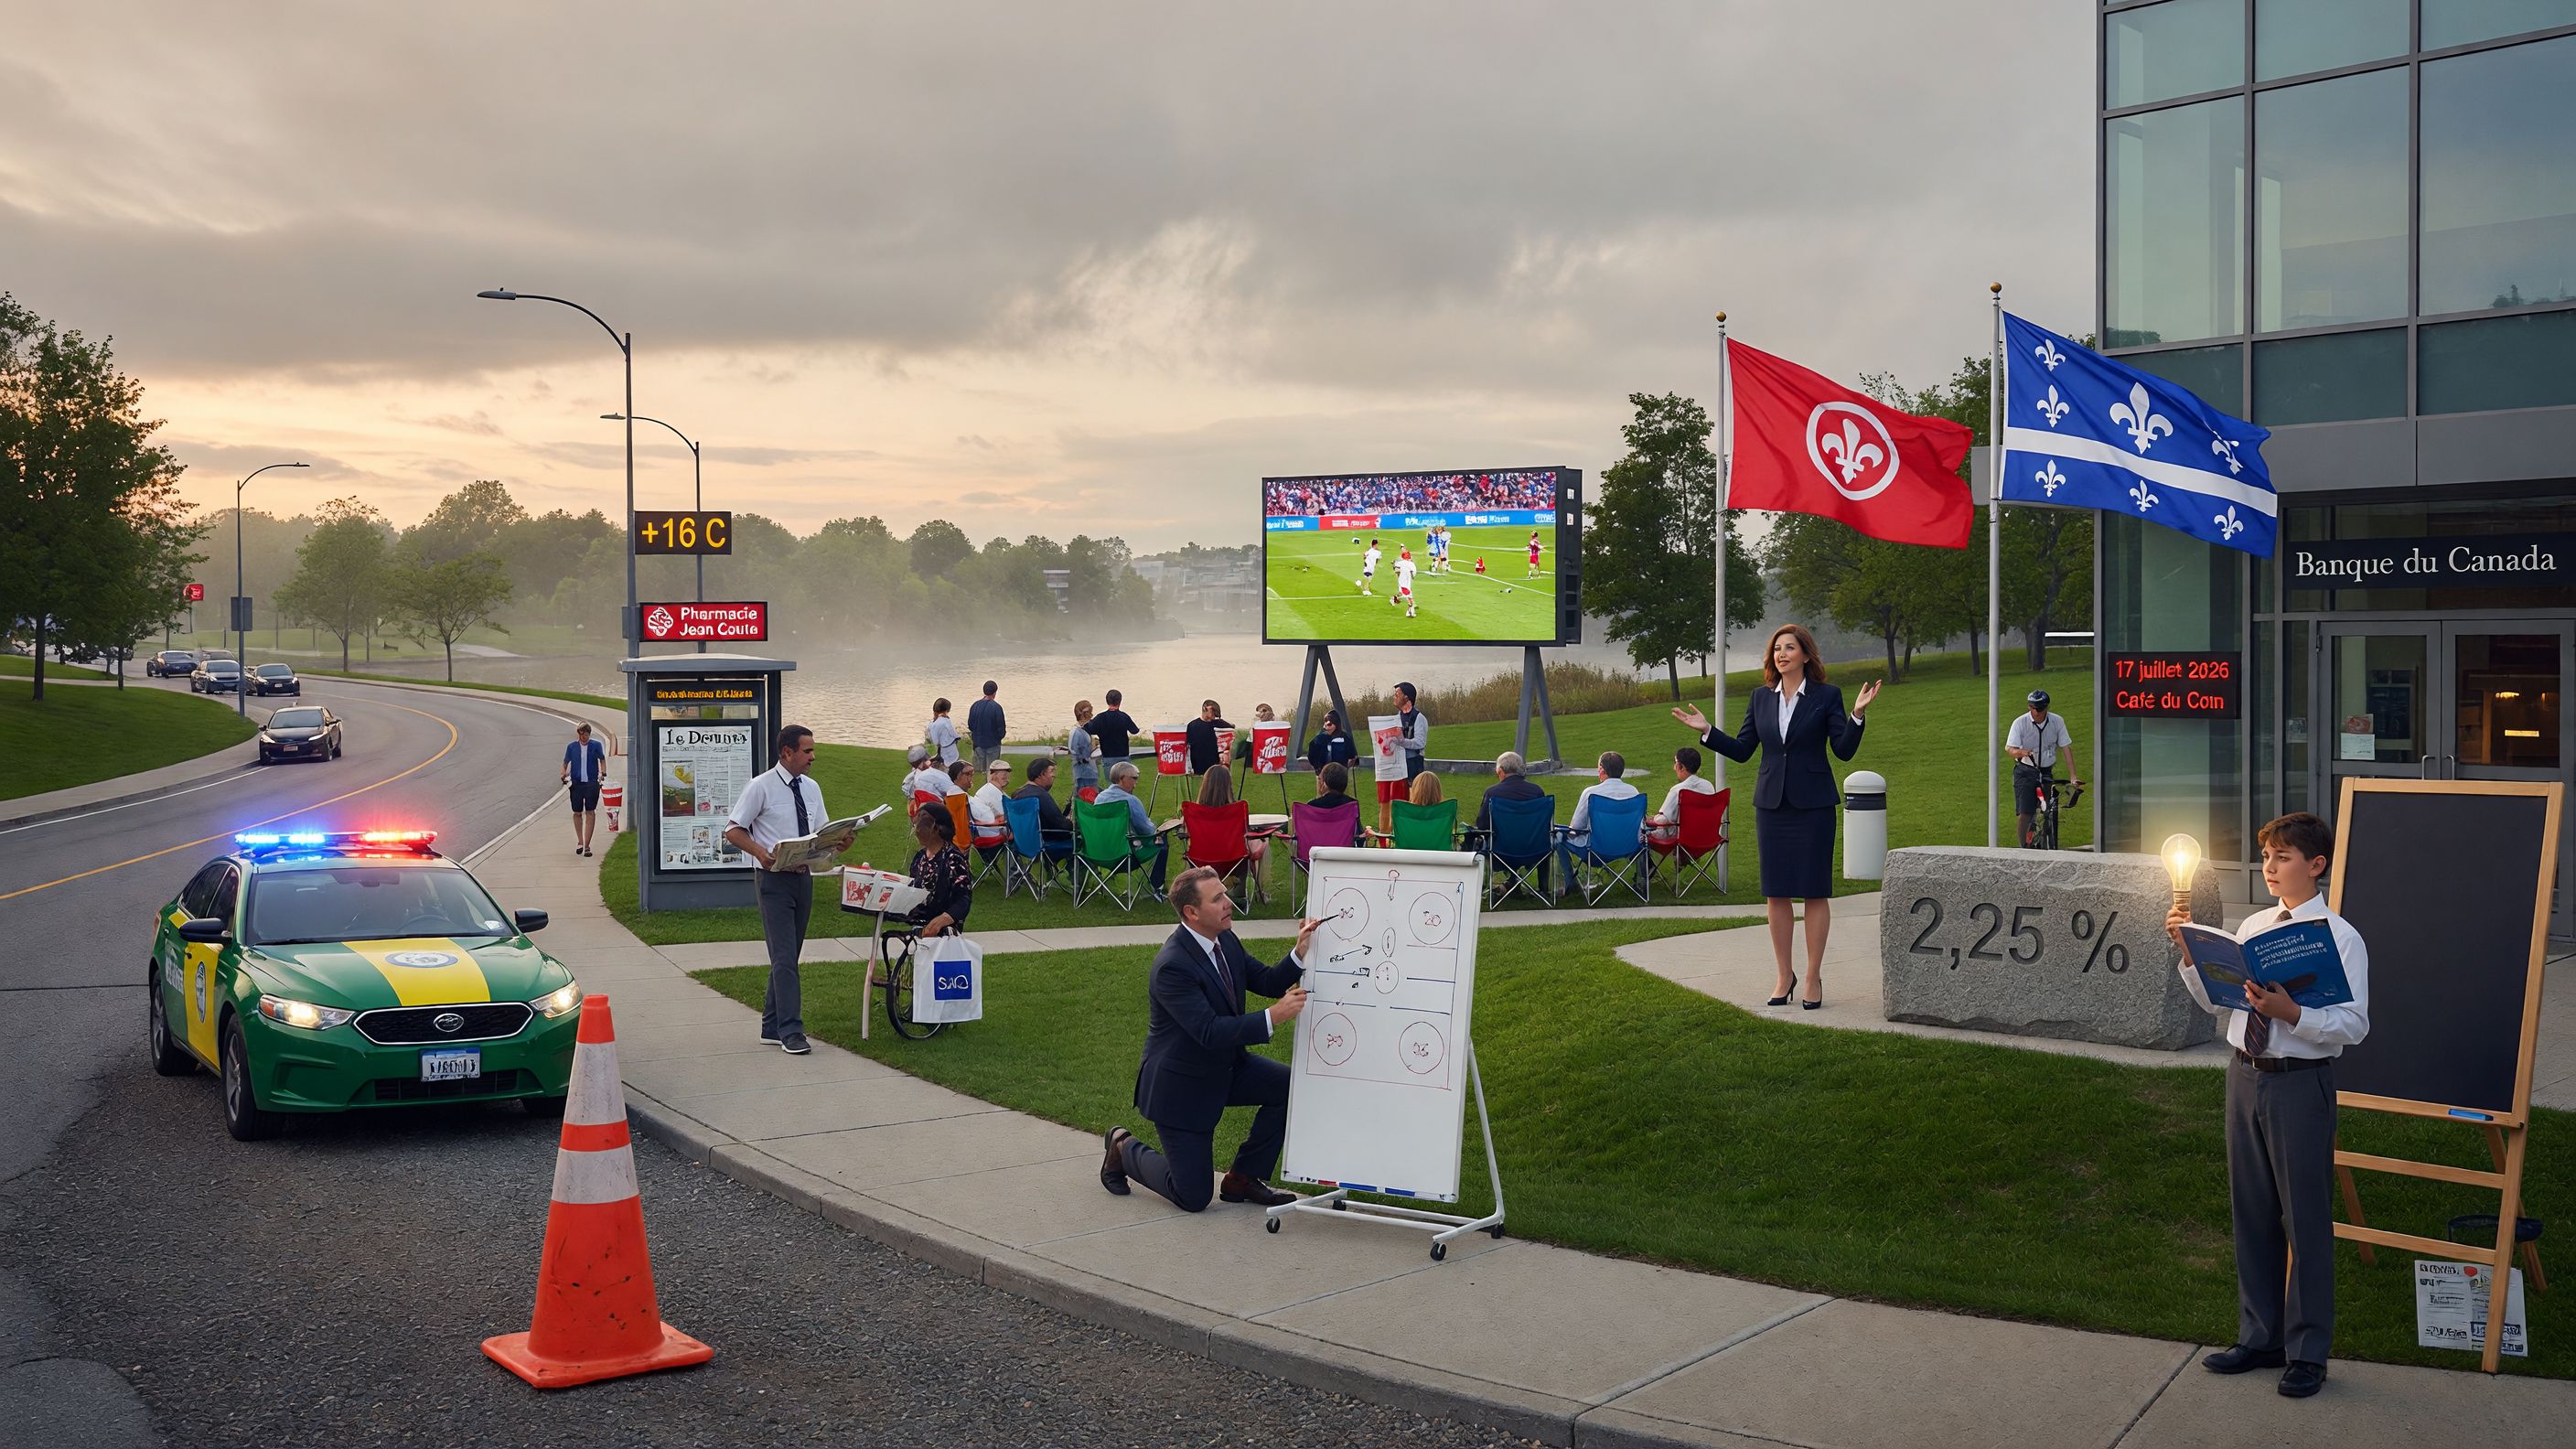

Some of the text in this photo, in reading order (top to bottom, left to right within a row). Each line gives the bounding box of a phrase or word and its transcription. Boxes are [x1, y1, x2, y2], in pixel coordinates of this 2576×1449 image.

[641, 517, 726, 548] +16 C
[2295, 544, 2557, 582] Banque du Canada
[681, 606, 757, 620] Pharmacie
[679, 623, 714, 636] Jean
[2116, 660, 2229, 682] 17 juillet 2026
[2161, 692, 2181, 709] du
[2187, 692, 2225, 709] Coin
[1909, 897, 2130, 974] 2,25 %
